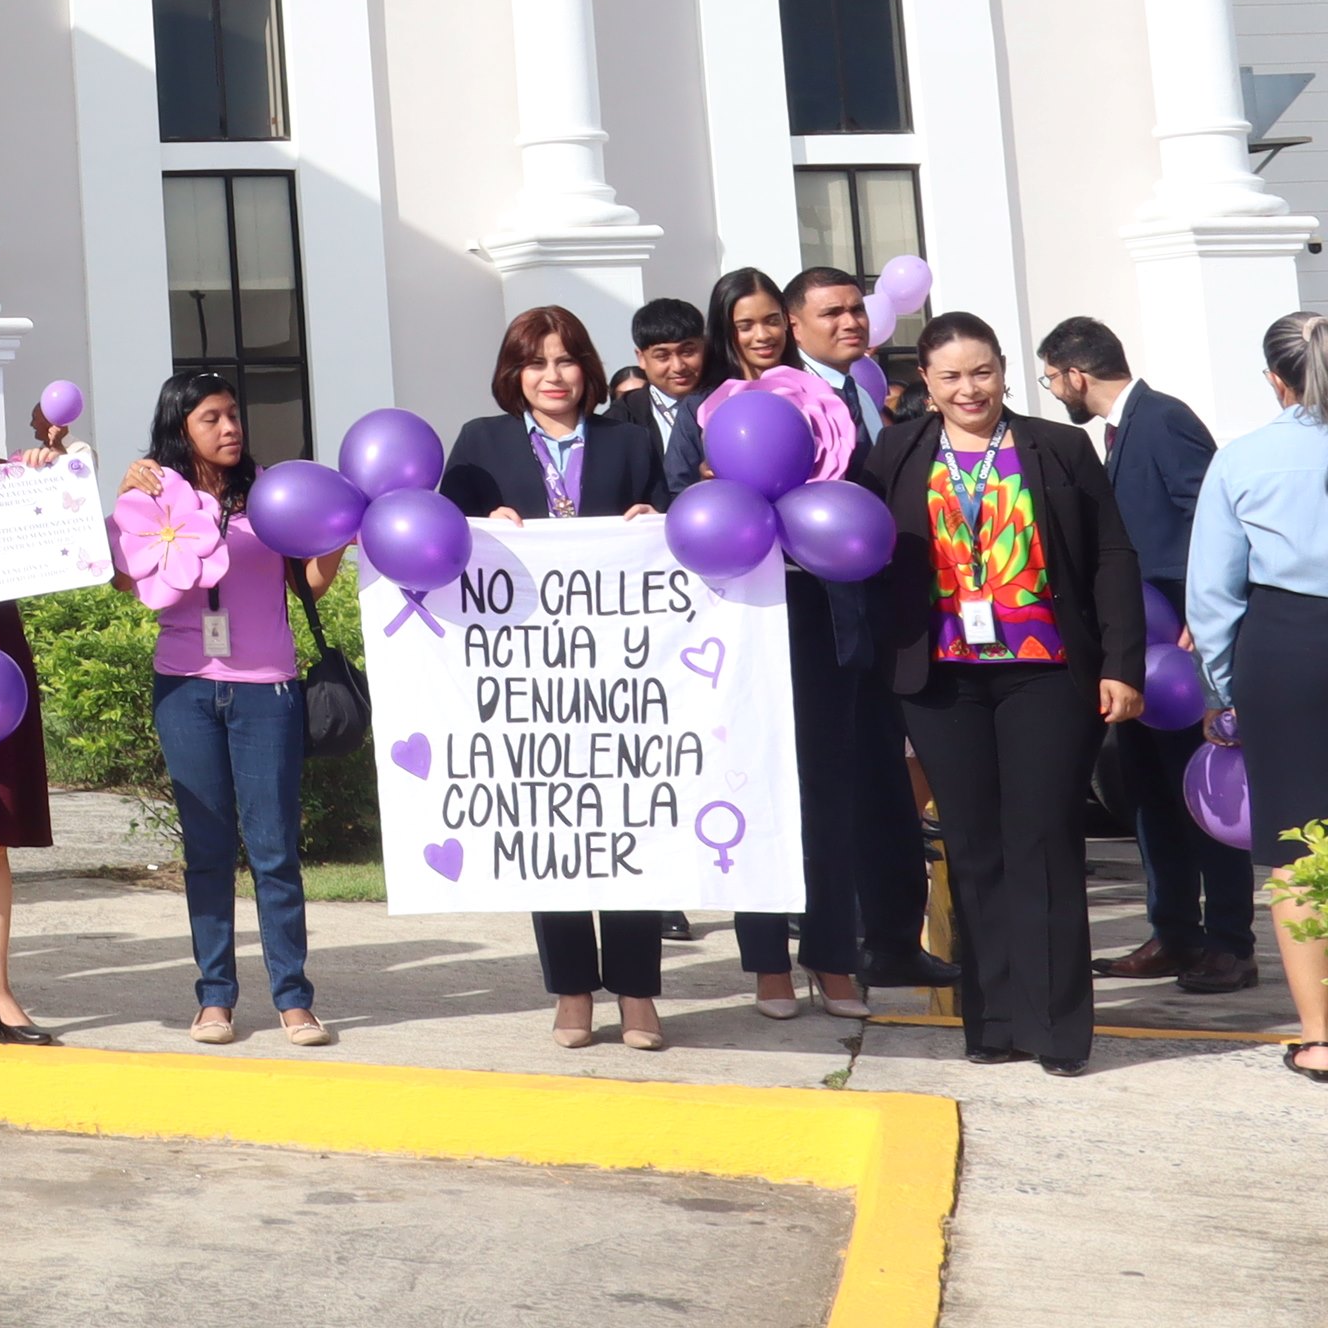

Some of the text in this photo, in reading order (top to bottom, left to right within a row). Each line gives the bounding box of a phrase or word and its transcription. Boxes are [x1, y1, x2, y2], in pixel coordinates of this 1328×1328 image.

[460, 568, 696, 623] NO CALLES,
[465, 619, 596, 669] ACTÚA
[477, 676, 668, 725] DENUNCIA
[446, 731, 703, 779] LA VIOLENCIA
[443, 782, 678, 829] CONTRA LA
[494, 831, 643, 880] MUJER
